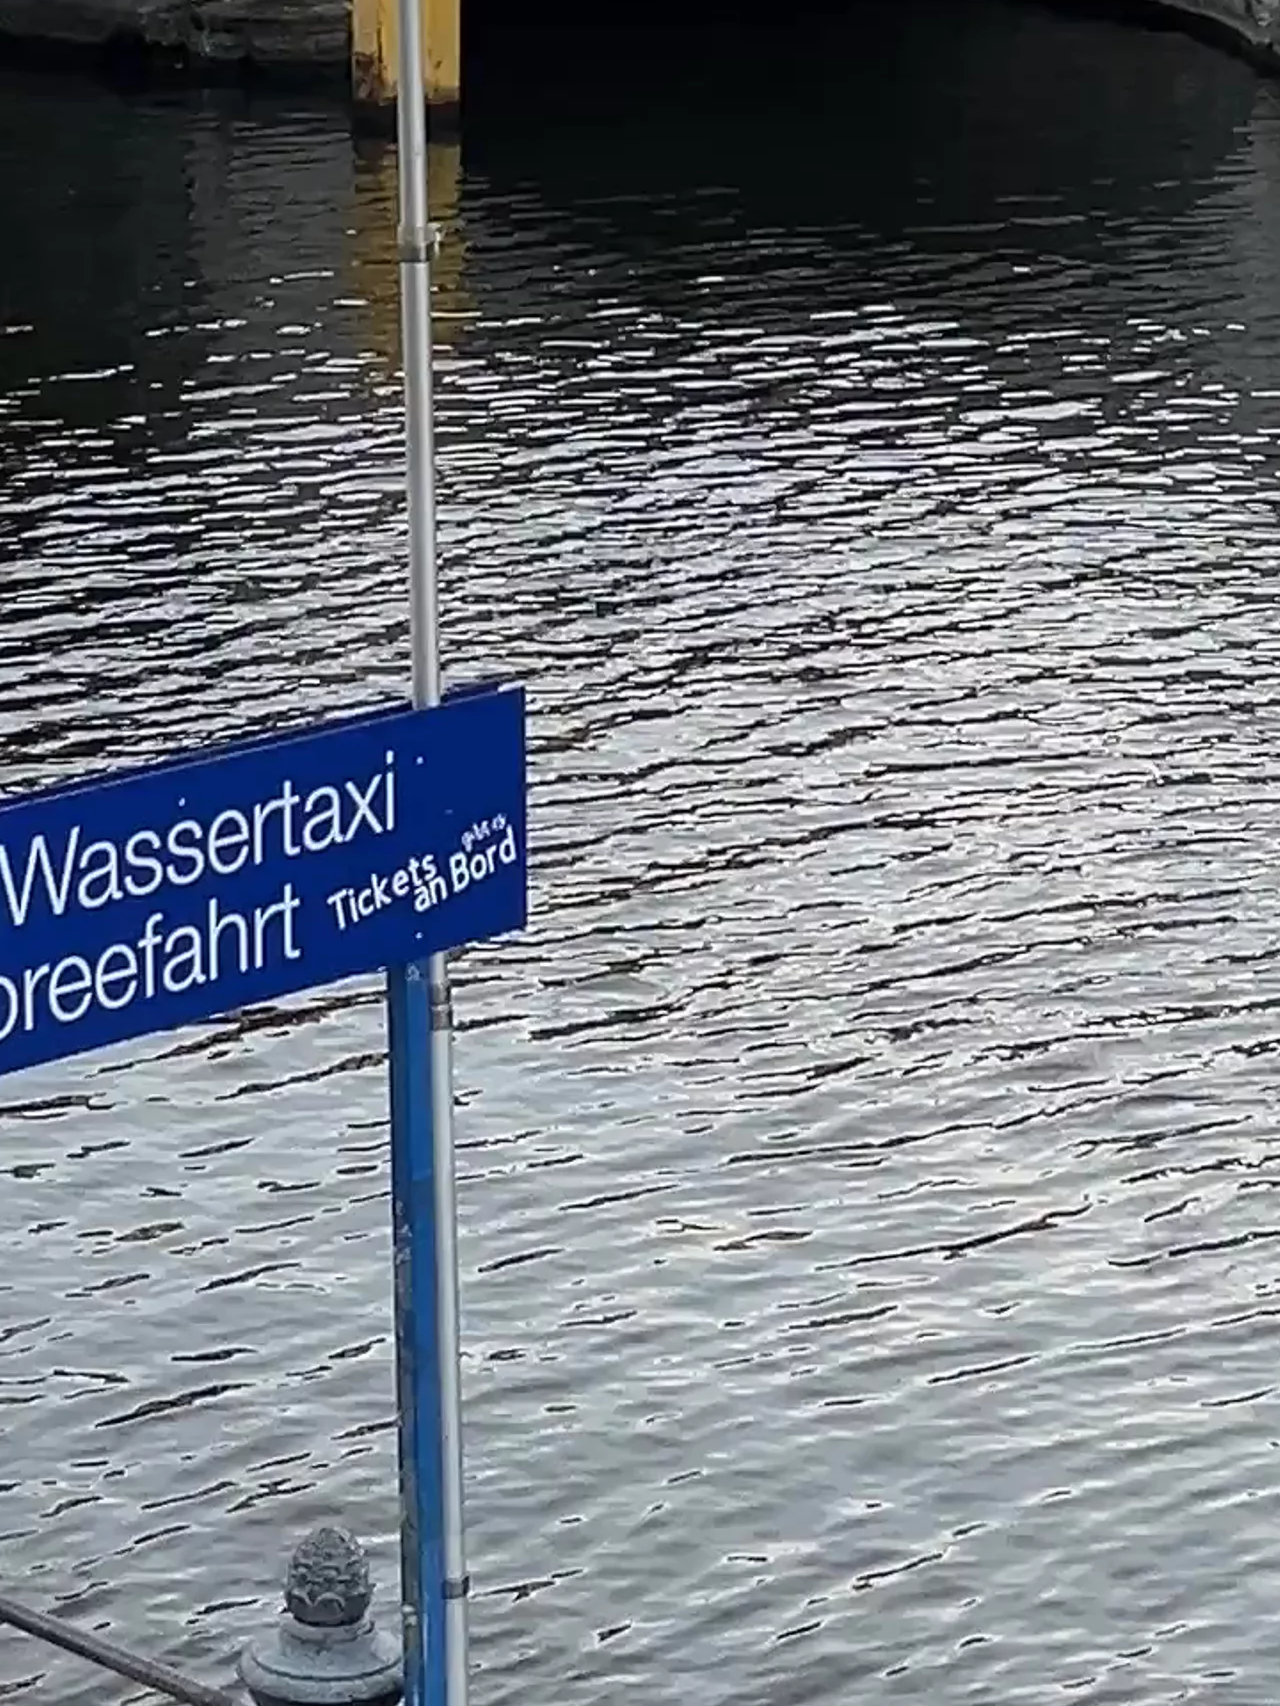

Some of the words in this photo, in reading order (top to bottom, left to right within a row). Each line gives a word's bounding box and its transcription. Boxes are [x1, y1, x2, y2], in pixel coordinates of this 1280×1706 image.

[326, 854, 437, 930] Tickets
[414, 876, 448, 912] an
[449, 824, 517, 893] Bord
